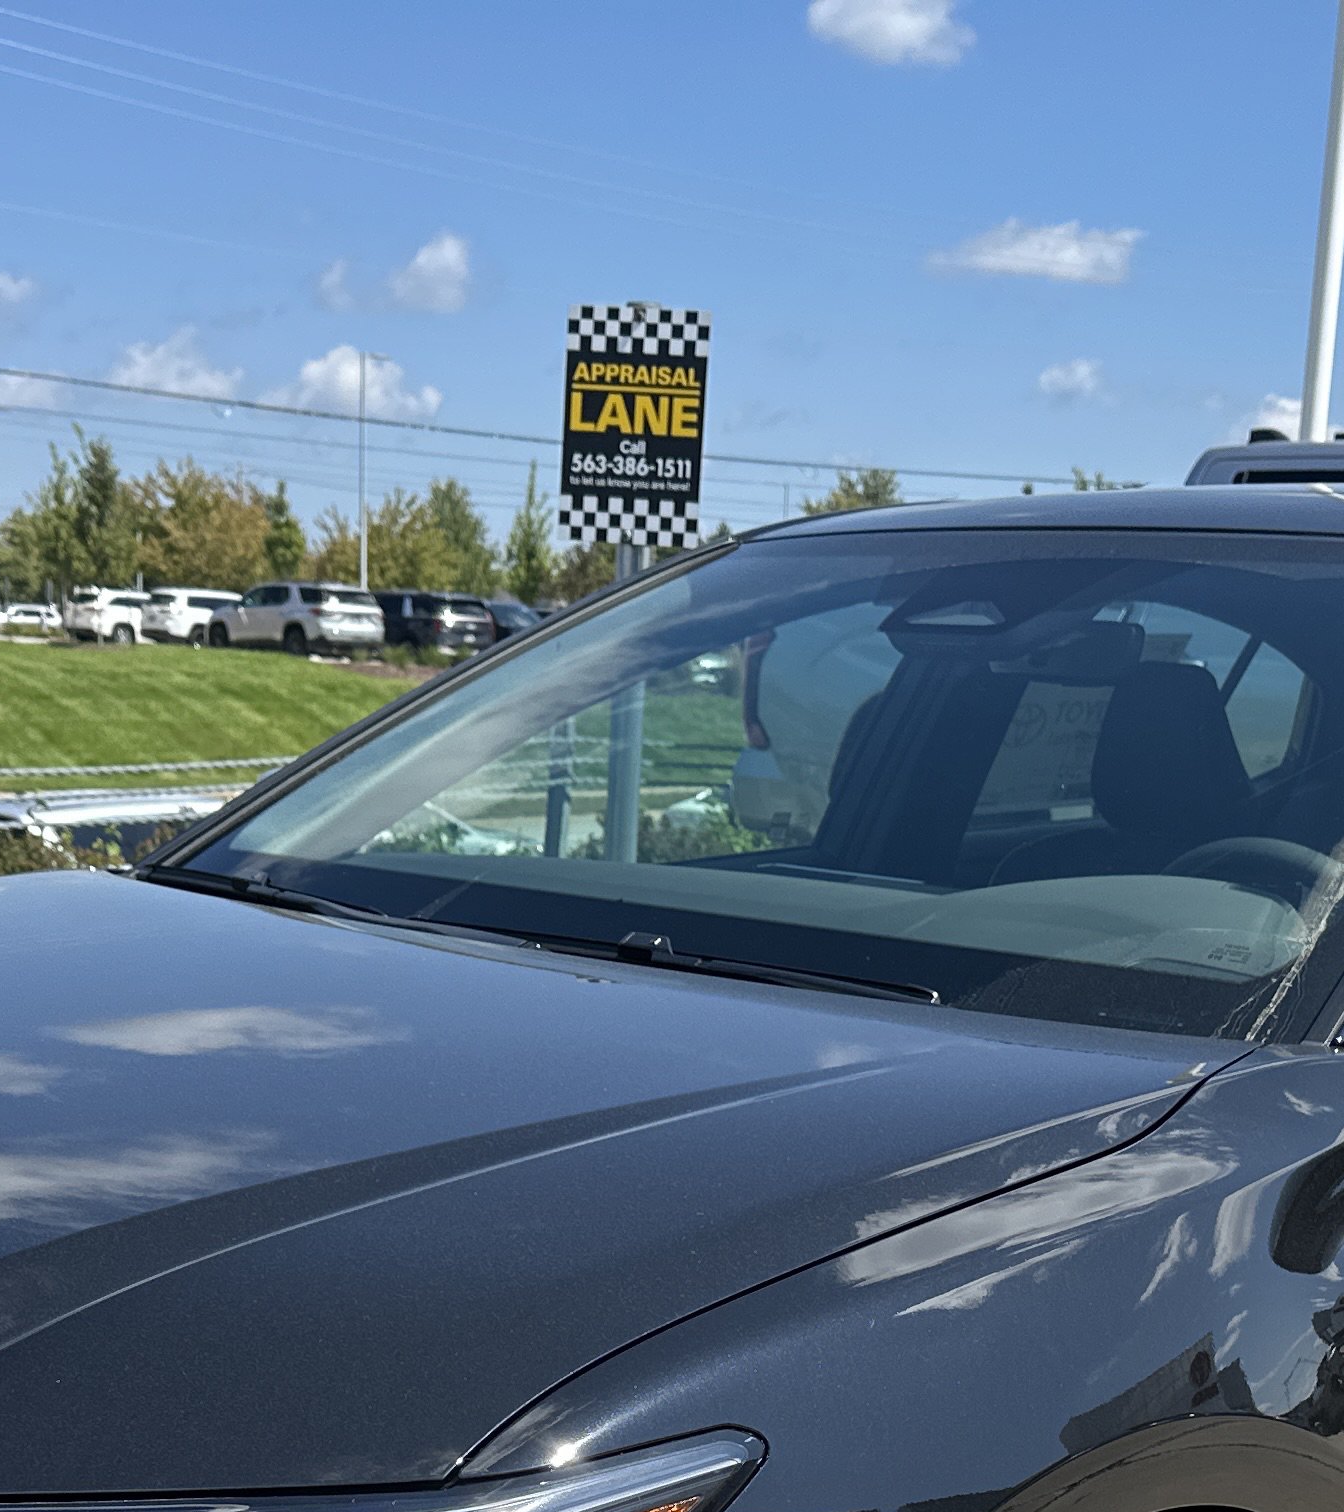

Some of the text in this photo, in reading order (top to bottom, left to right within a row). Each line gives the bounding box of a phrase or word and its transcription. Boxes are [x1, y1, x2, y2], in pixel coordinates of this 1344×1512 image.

[573, 361, 701, 387] APPRAISAL
[569, 391, 700, 438] LANE
[619, 440, 646, 455] Call
[570, 453, 692, 479] 563-386-1511
